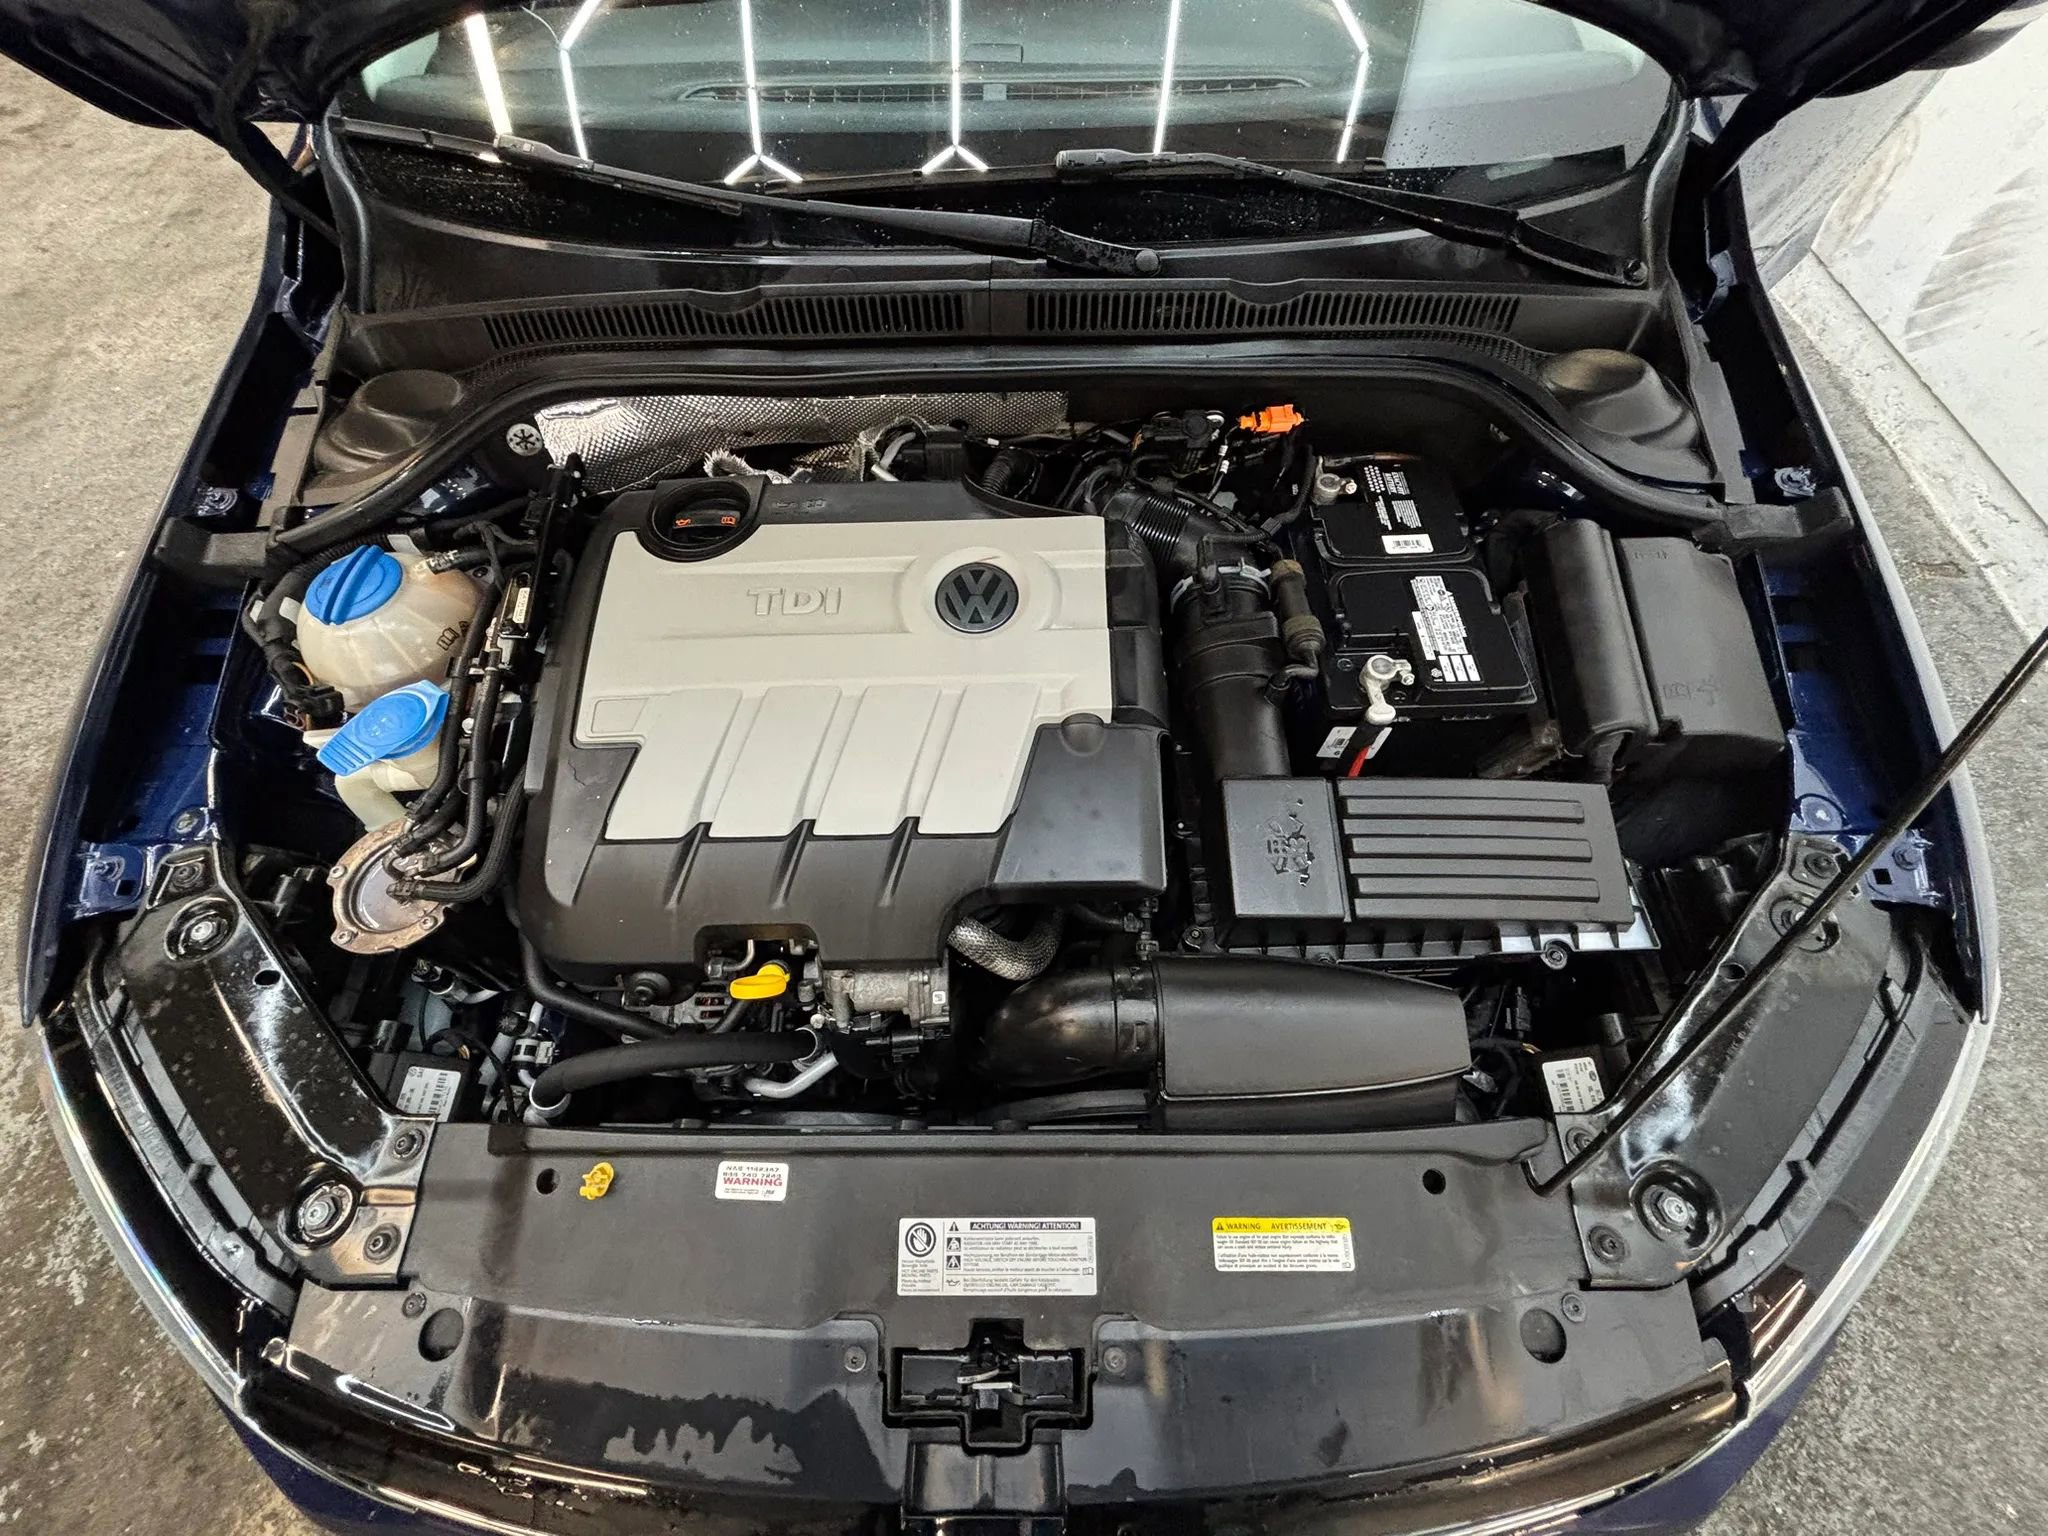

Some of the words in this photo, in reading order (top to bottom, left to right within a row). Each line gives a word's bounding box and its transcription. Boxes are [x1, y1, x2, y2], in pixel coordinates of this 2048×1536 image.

[747, 586, 842, 616] TDI
[939, 566, 1016, 630] VW
[723, 1177, 783, 1186] WARNING
[971, 1222, 1006, 1231] ACHTUNG!
[1007, 1222, 1041, 1231] WARNING!
[1041, 1222, 1080, 1231] ATTENTION!
[1271, 1222, 1327, 1231] AVERTISSEMENT
